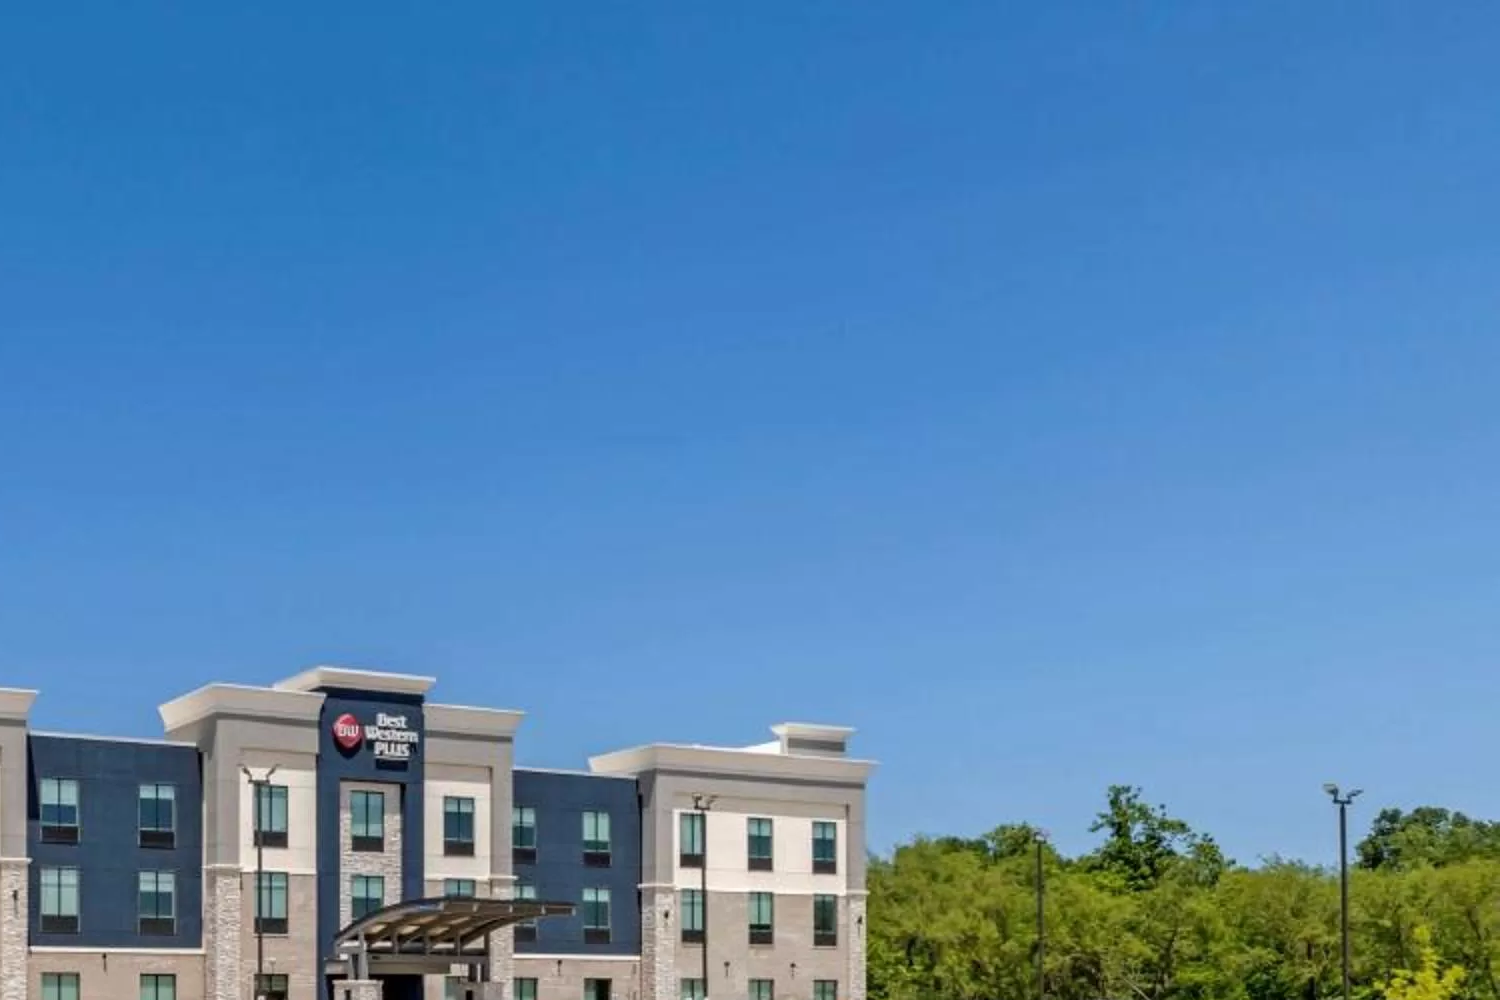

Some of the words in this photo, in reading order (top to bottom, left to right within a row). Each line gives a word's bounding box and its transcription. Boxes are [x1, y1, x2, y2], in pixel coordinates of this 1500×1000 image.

[376, 713, 407, 728] Best
[365, 726, 419, 742] Western
[374, 741, 409, 756] PLUS
